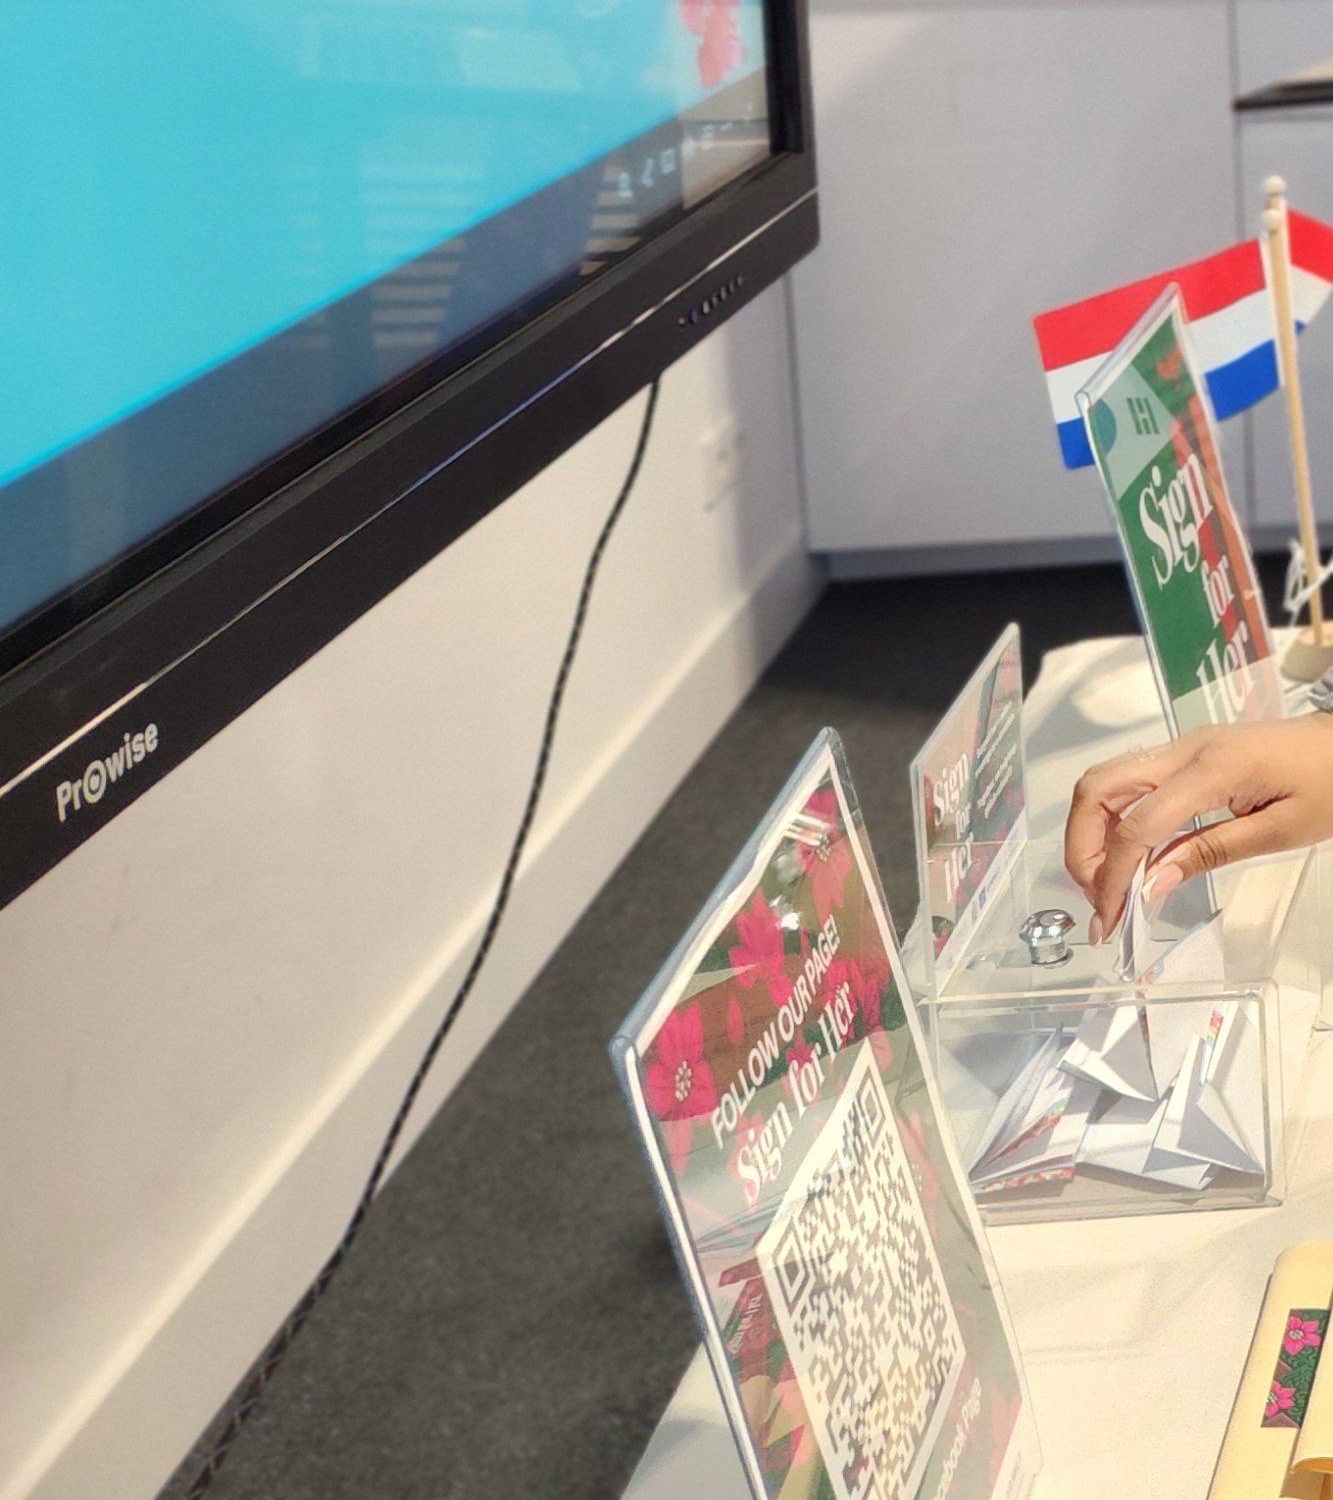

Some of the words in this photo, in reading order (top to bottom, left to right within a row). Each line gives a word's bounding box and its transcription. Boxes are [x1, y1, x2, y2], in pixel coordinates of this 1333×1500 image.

[1139, 453, 1214, 590] Sign
[1201, 554, 1235, 629] for
[1196, 619, 1255, 726] Her
[932, 752, 970, 828] Sign
[955, 802, 972, 841] for
[944, 831, 974, 904] Her
[710, 1021, 779, 1151] FOLLOW
[777, 978, 807, 1044] OUR
[799, 913, 841, 1007] PAGE!
[737, 1099, 794, 1204] Sign
[787, 1042, 827, 1119] for
[816, 980, 859, 1062] Her
